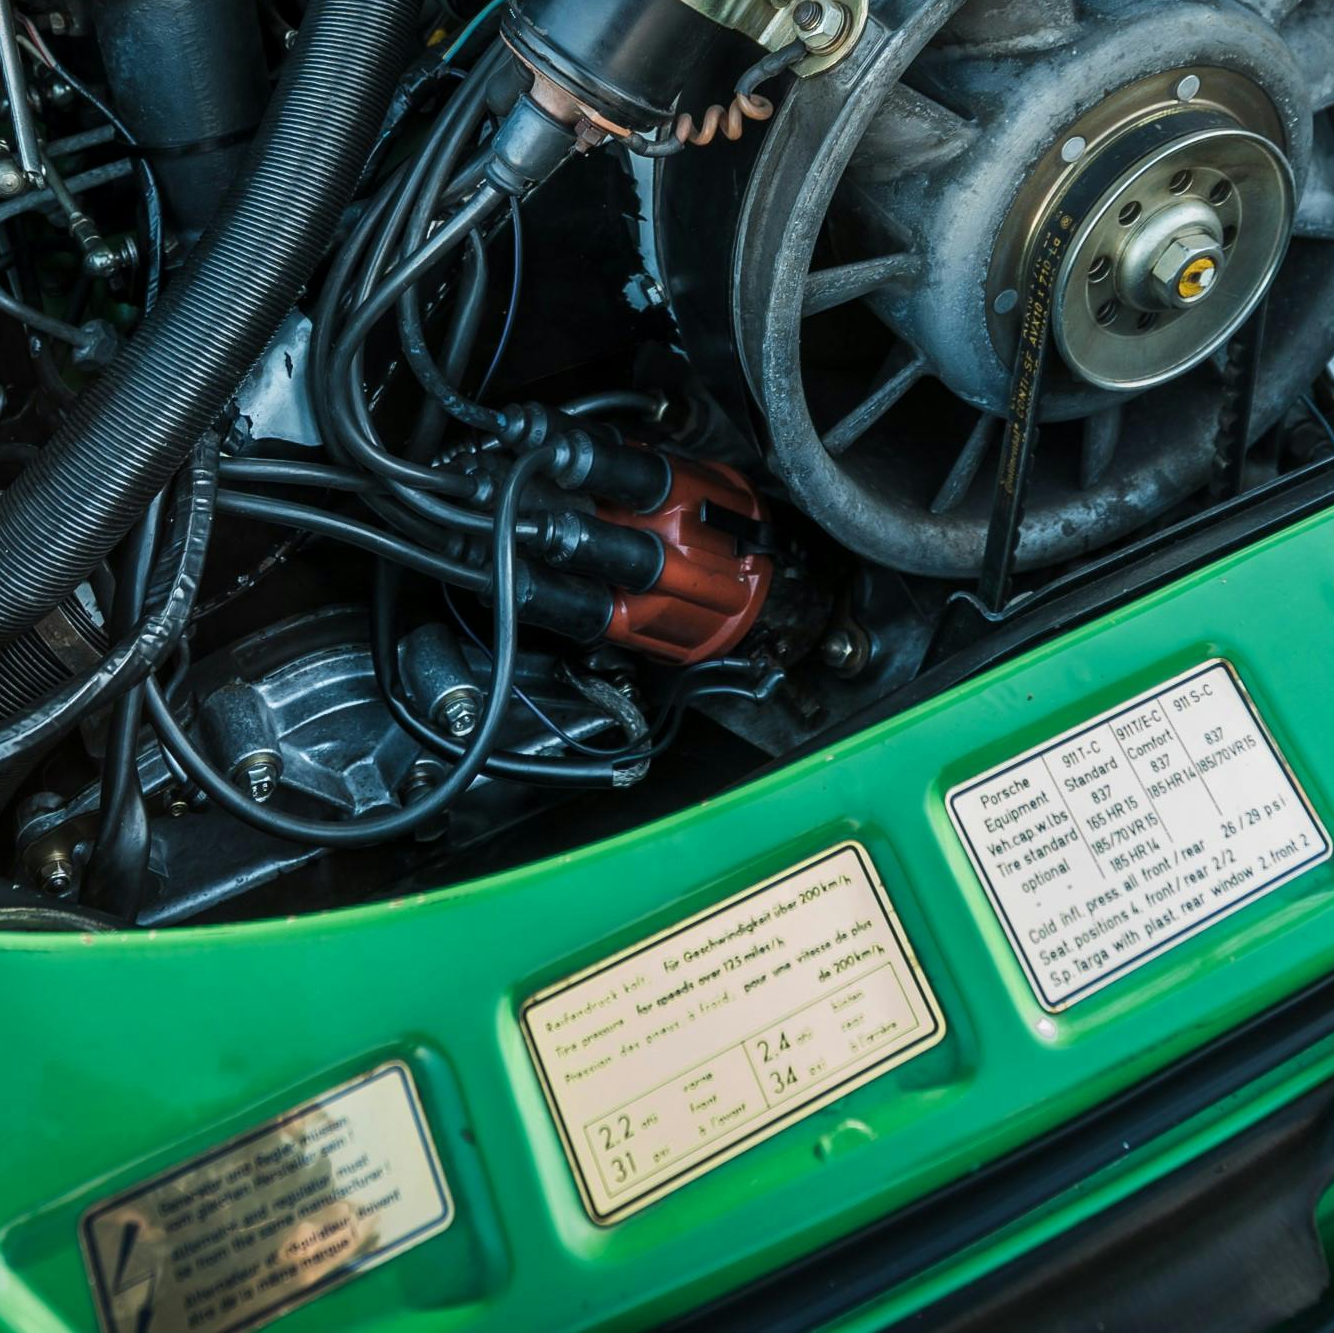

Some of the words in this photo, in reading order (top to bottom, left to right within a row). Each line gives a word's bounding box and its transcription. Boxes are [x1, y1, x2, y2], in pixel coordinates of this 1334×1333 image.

[1015, 351, 1034, 418] CONTI-SF
[1028, 301, 1043, 346] AVX10
[1038, 260, 1052, 286] 710
[979, 777, 1030, 808] Porsche
[983, 790, 1049, 833] Equipment
[1063, 756, 1118, 792] Standard
[1126, 728, 1173, 760] Comfort
[1090, 783, 1111, 804] 837
[1149, 752, 1170, 773] 837
[1203, 725, 1223, 745] 837
[995, 859, 1021, 876] Tire
[1023, 827, 1078, 864] standard
[1085, 812, 1107, 830] 165
[1021, 857, 1070, 893] optional
[1027, 918, 1058, 944] Cold
[1058, 905, 1082, 926] infl.
[1085, 888, 1119, 916] press.
[1123, 873, 1138, 892] all
[1140, 856, 1171, 881] front
[1180, 839, 1204, 859] rear
[1220, 820, 1237, 839] 26
[1244, 807, 1261, 825] 29
[1109, 853, 1130, 871] 185
[1073, 910, 1129, 949] positions
[1183, 865, 1208, 884] rear
[1211, 848, 1236, 871] 2/2
[1112, 929, 1140, 952] with
[1180, 893, 1204, 913] rear
[1210, 867, 1253, 896] window
[1299, 832, 1310, 847] 2
[662, 959, 680, 972] für
[682, 912, 770, 962] Geschwindigkeit
[773, 900, 796, 917] über
[798, 885, 820, 904] 200
[743, 974, 766, 993] pour
[772, 961, 791, 975] une
[796, 941, 831, 963] vitesse
[834, 931, 848, 943] de
[850, 919, 872, 936] plus
[818, 969, 831, 981] de
[832, 952, 857, 973] 200
[853, 944, 885, 961] km/h
[635, 1002, 653, 1014] for
[655, 980, 694, 1006] speeds
[697, 968, 721, 983] over
[722, 954, 742, 971] 125
[743, 937, 784, 960] miles/h
[756, 1031, 791, 1063] 2.4
[769, 1065, 798, 1093] 34
[598, 1114, 634, 1151] 2.2
[610, 1151, 636, 1183] 31
